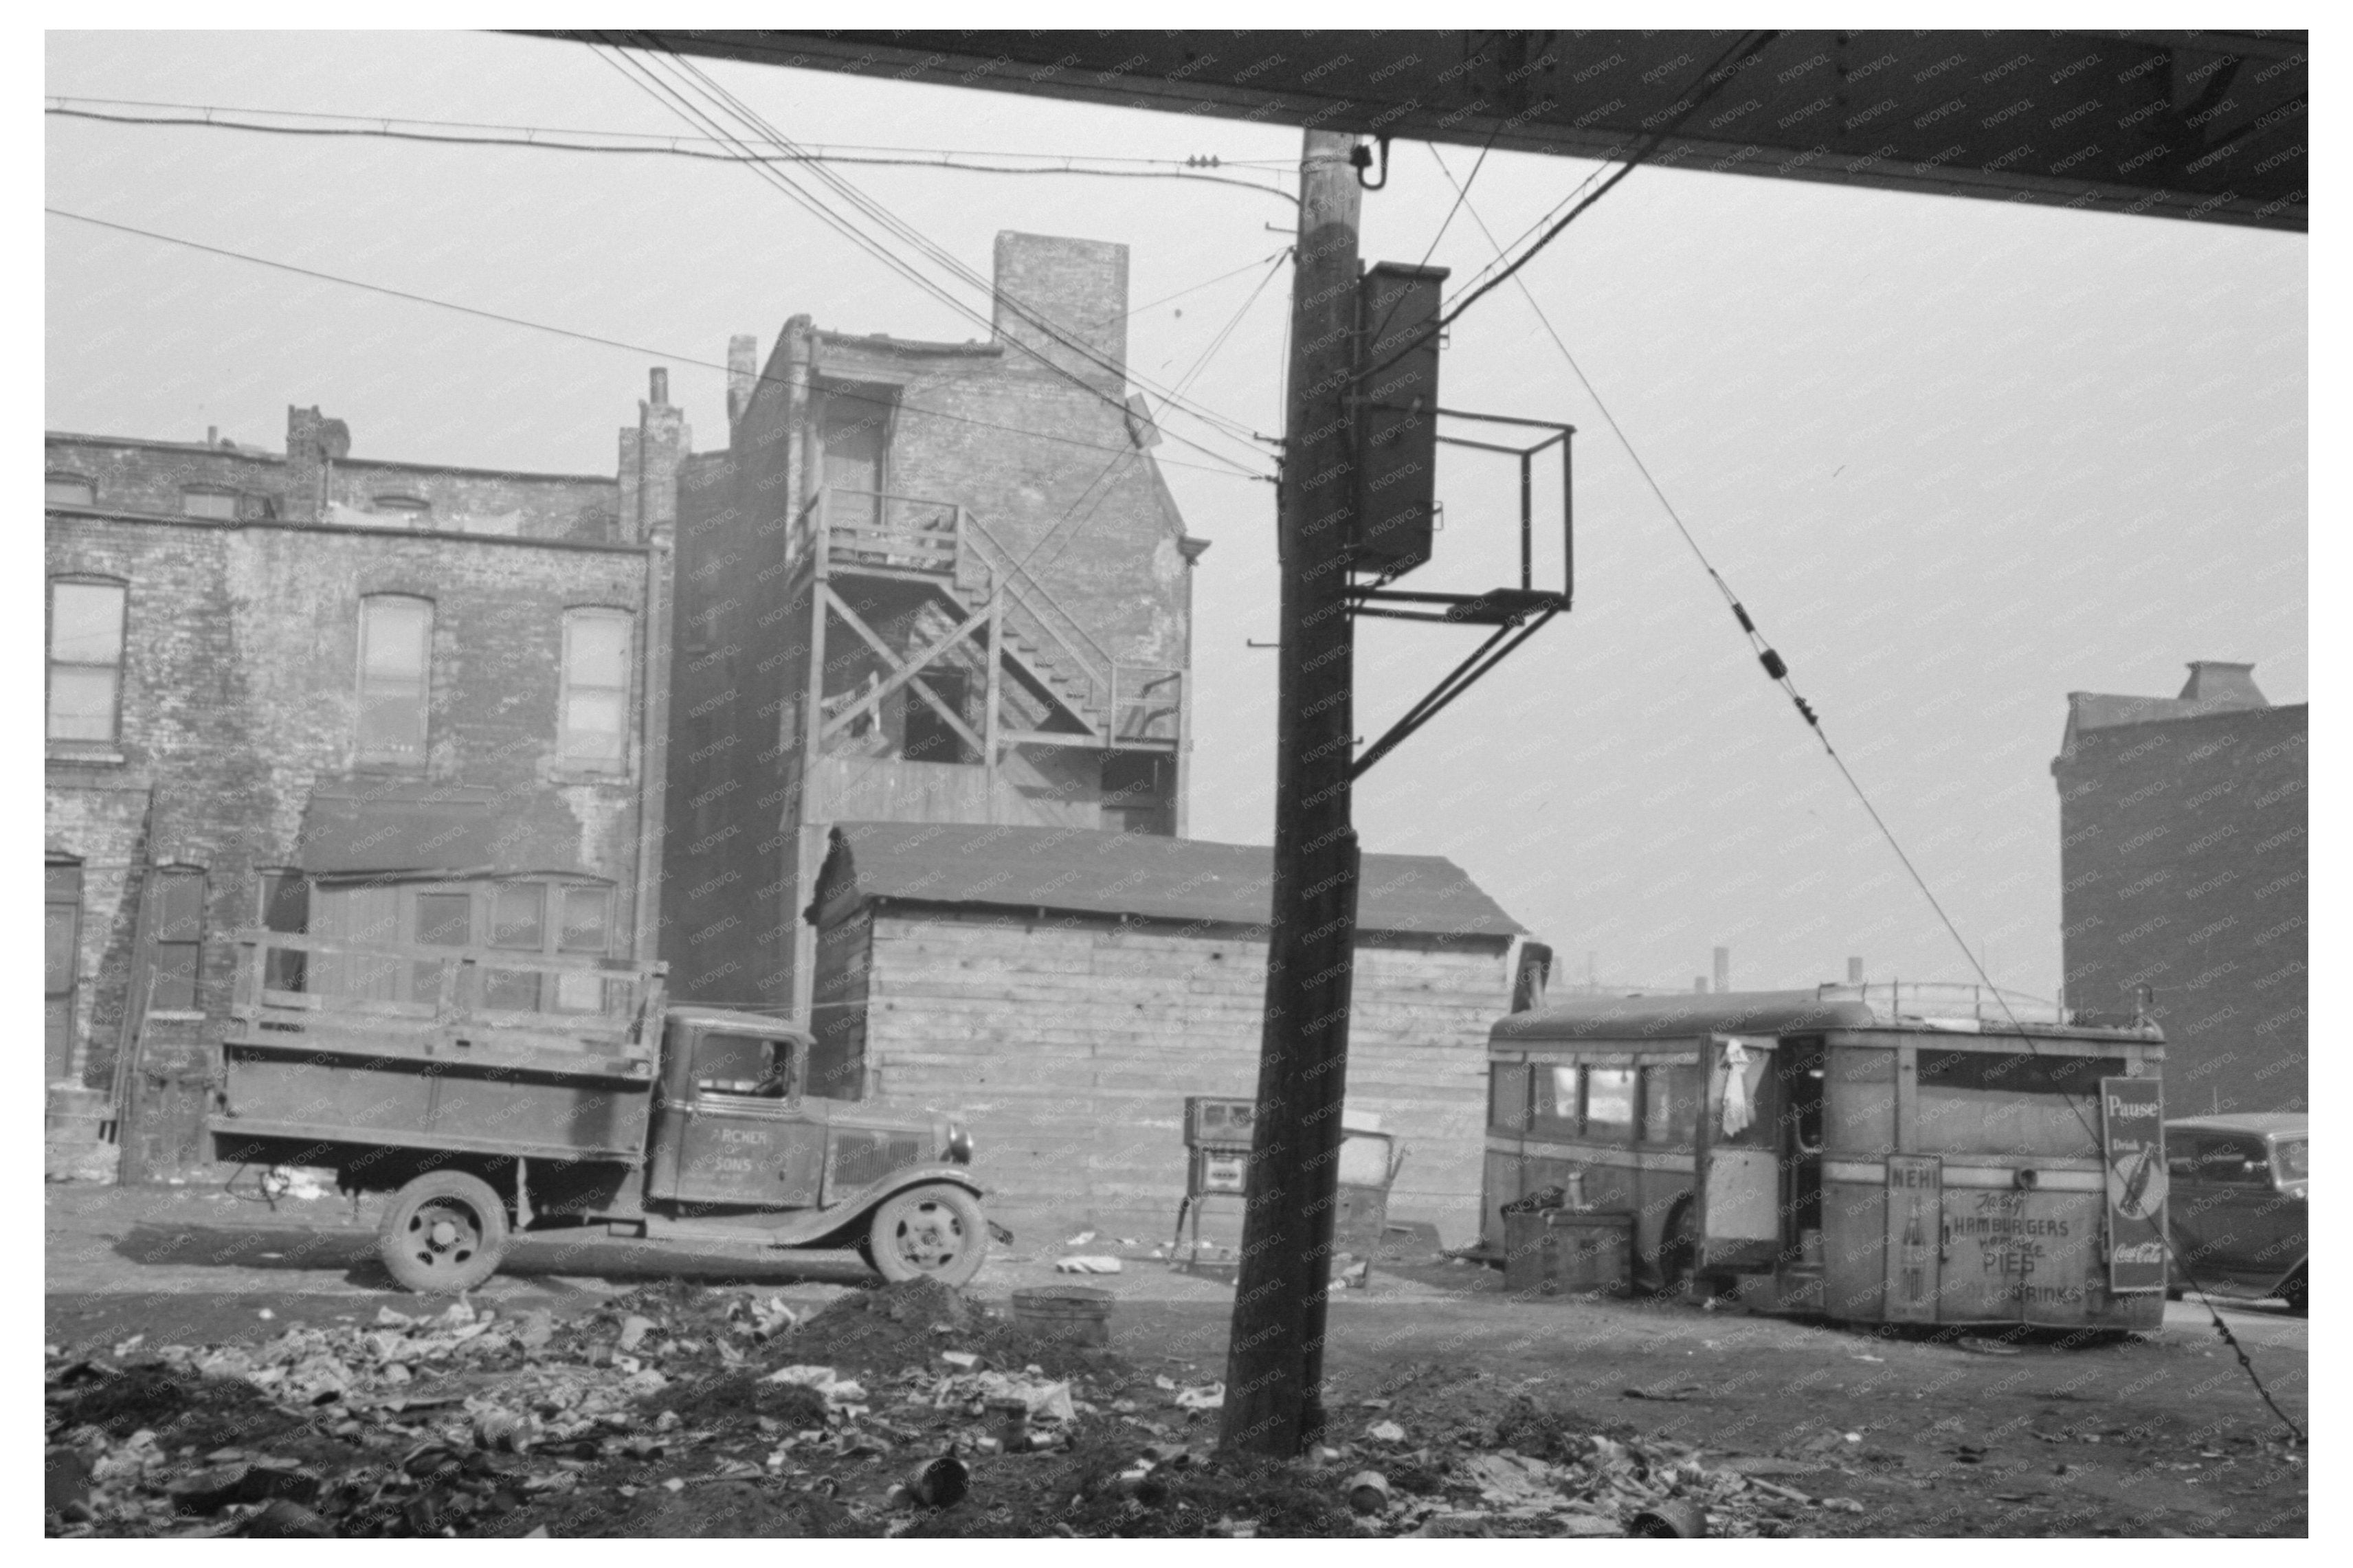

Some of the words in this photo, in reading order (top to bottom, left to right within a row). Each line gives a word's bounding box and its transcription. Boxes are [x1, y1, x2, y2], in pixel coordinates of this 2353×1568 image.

[2108, 1095, 2158, 1117] Pause
[713, 1156, 752, 1172] SONS
[1892, 1169, 1937, 1189] NEHI
[1954, 1217, 2069, 1236] HAMBURGERS
[1983, 1252, 2035, 1273] PIES
[2011, 1284, 2082, 1304] DRINKS
